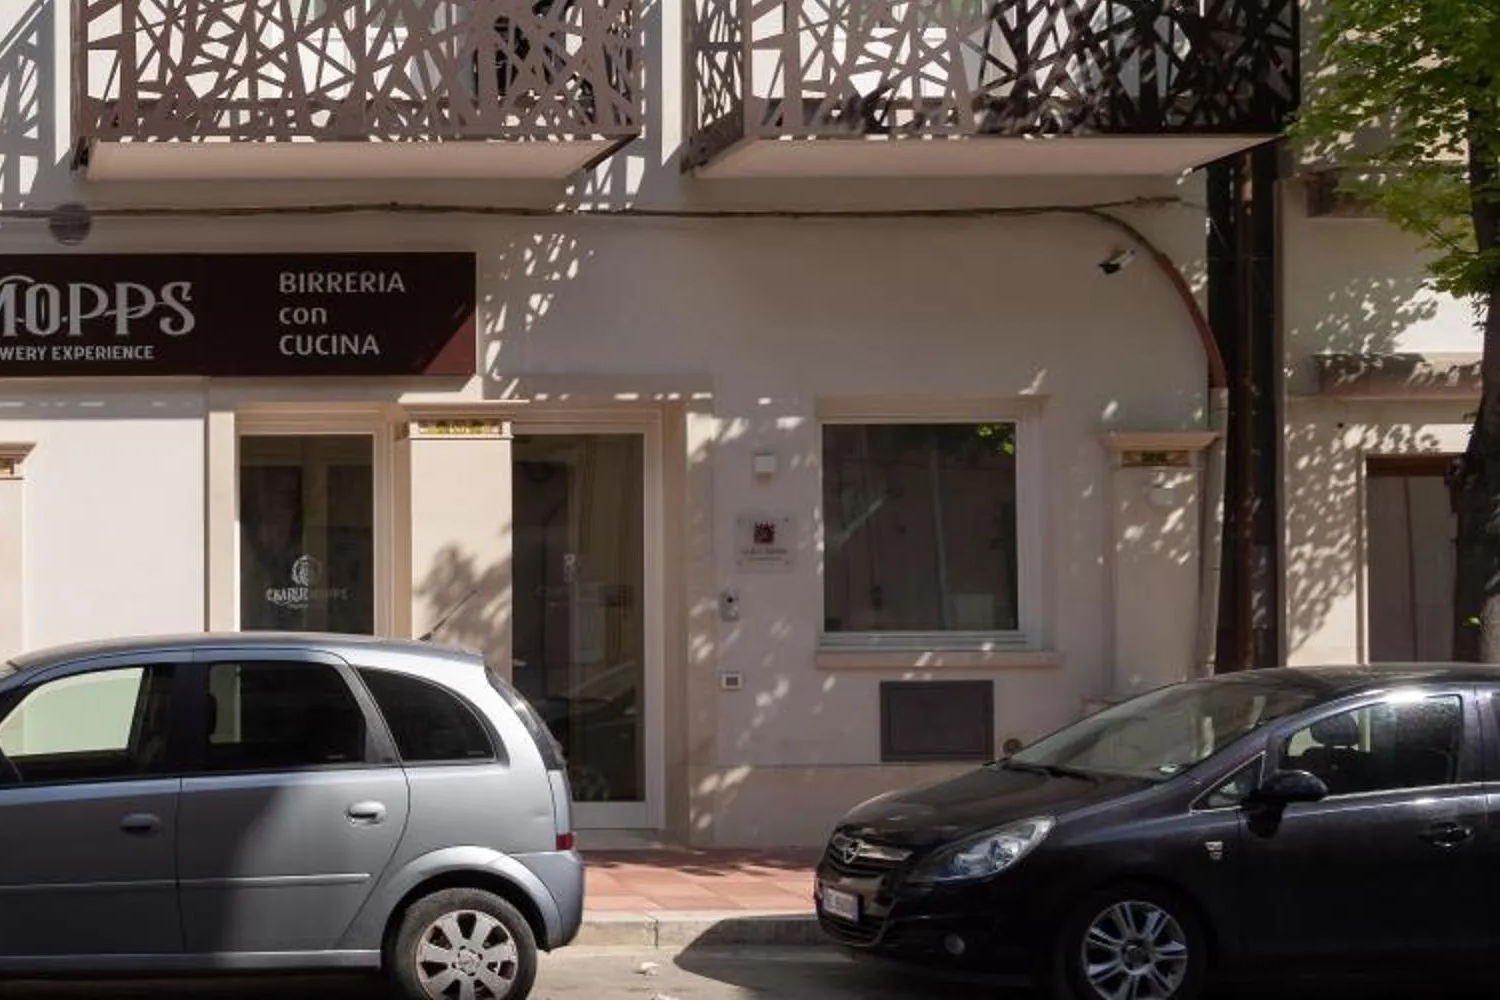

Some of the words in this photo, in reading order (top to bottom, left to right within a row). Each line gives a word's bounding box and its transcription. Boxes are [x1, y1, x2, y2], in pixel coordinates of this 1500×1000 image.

[279, 272, 406, 294] BIRRERIA
[278, 307, 328, 325] con
[51, 345, 156, 361] EXPERIENCE
[279, 333, 381, 356] CUCINA
